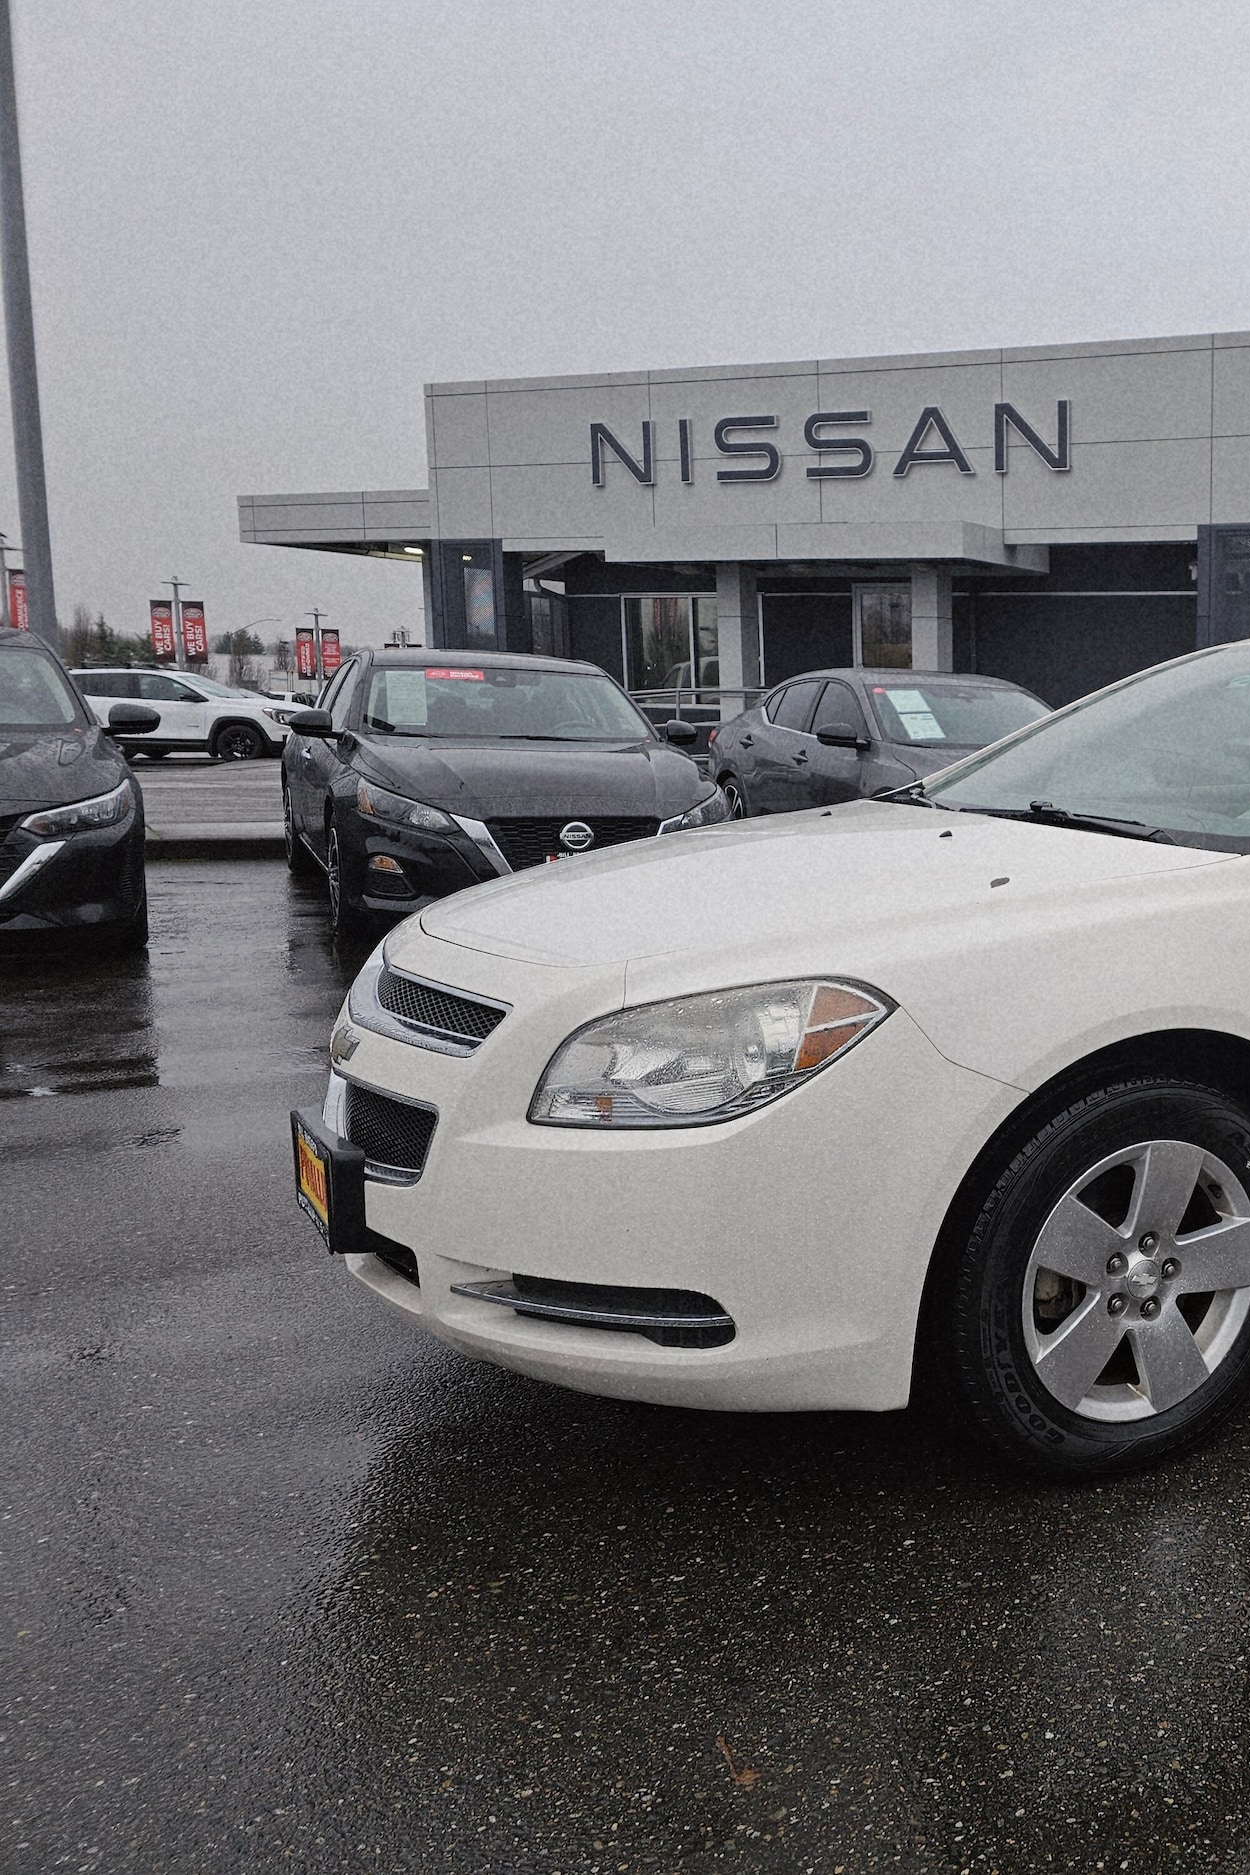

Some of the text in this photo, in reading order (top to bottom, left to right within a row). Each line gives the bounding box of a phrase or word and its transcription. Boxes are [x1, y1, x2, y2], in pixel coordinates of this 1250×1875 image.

[590, 400, 1070, 487] NISSAN
[154, 620, 163, 639] BUY
[163, 624, 172, 651] CARS!
[185, 621, 195, 640] BUY
[195, 625, 204, 652] CARS!
[156, 641, 164, 655] WE
[187, 641, 196, 656] WE
[563, 832, 593, 840] NISSAN
